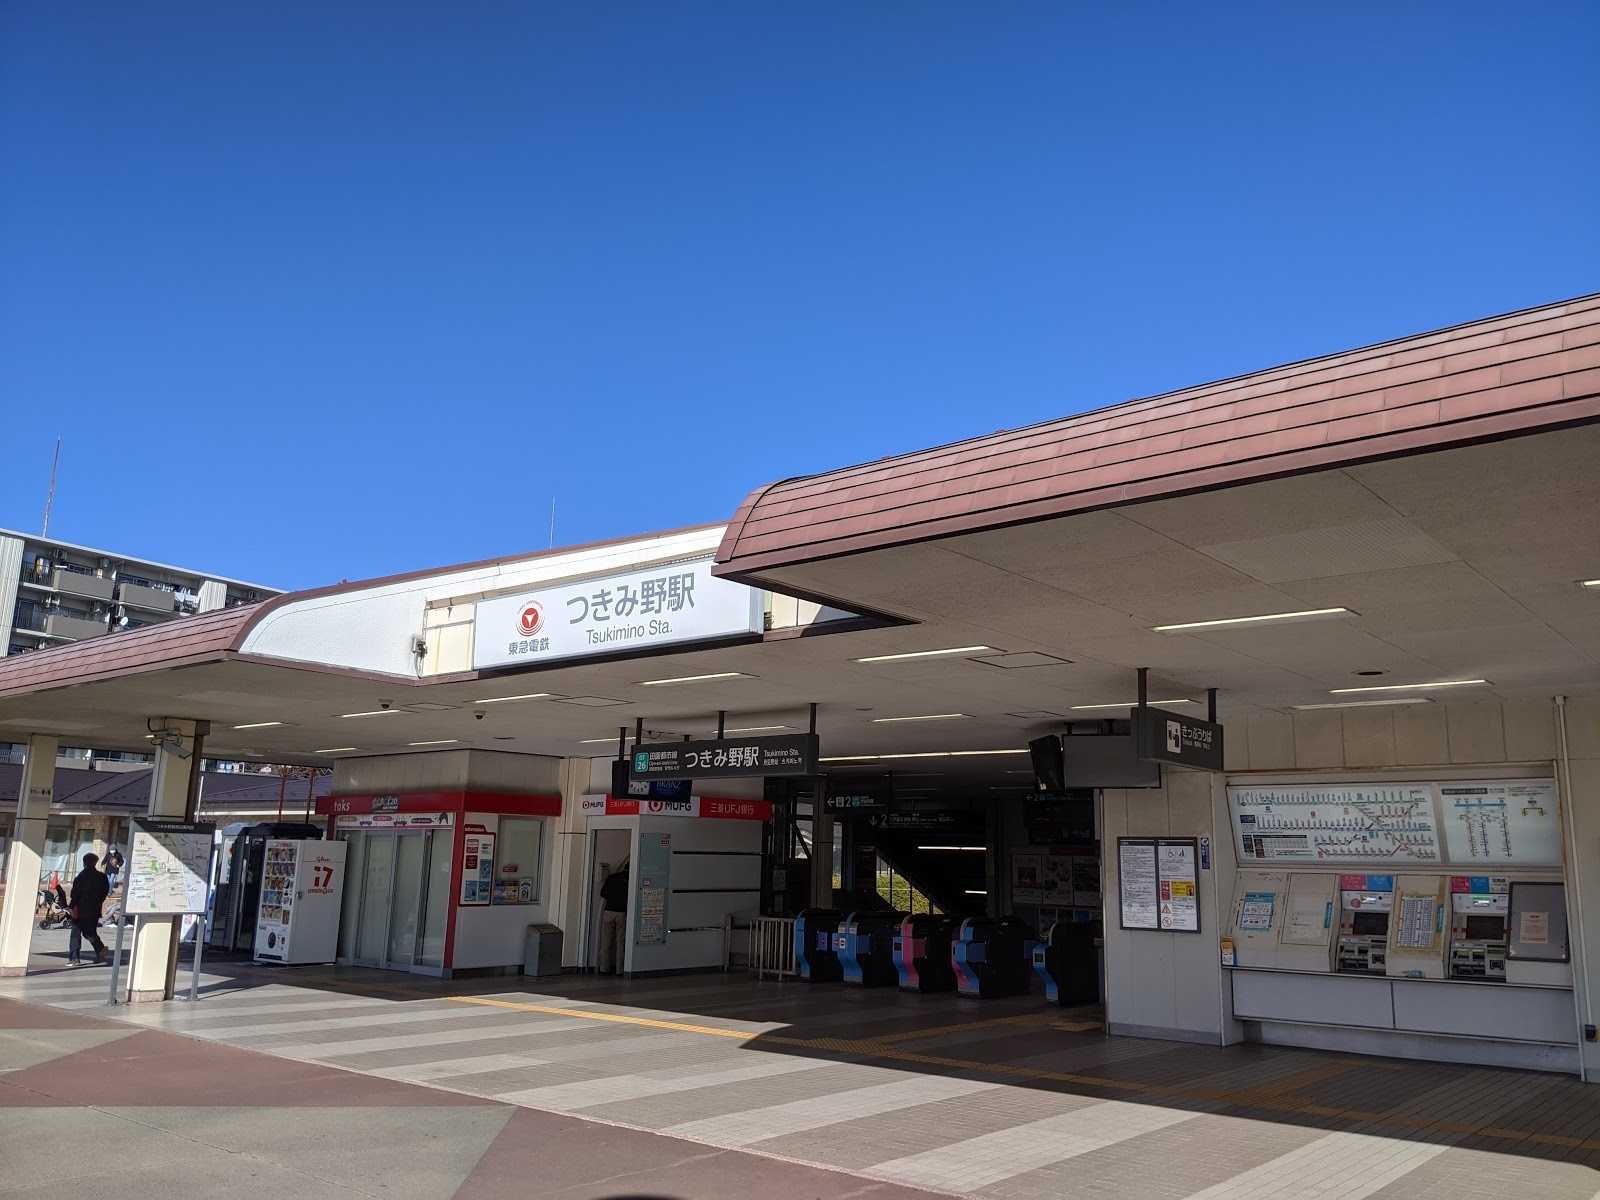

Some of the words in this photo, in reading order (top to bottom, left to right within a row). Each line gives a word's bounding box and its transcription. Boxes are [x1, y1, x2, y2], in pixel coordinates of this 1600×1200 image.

[566, 571, 695, 625] つきみ野駅
[586, 624, 645, 646] Tsukimino
[649, 619, 673, 636] Sta.
[508, 637, 550, 655] 東急電鉄
[1181, 726, 1213, 743] きっぷうりば
[637, 761, 646, 770] 26
[685, 746, 760, 769] つきみ野駅
[664, 800, 692, 812] MUFG
[845, 795, 851, 808] 2
